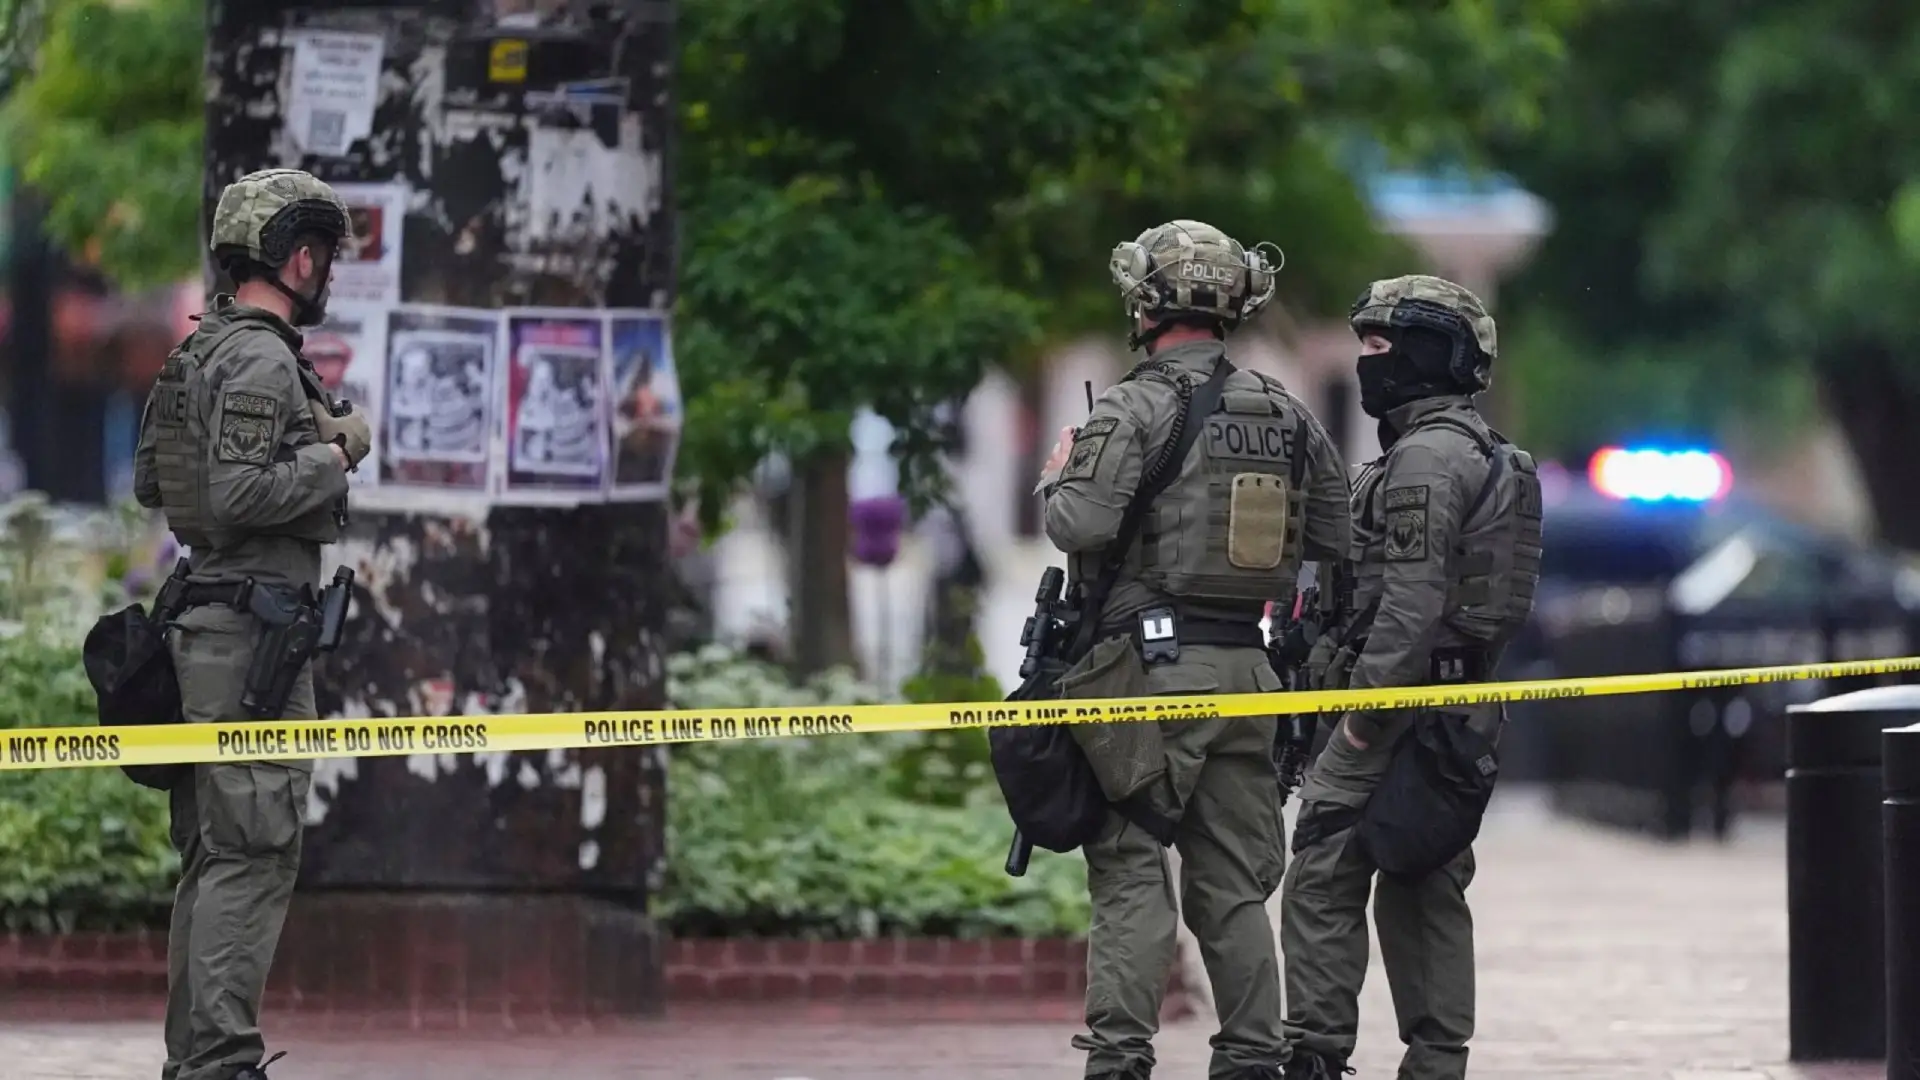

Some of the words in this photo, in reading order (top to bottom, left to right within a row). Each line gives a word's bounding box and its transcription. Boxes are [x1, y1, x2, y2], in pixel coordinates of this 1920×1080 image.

[1182, 261, 1233, 284] POLICE
[1209, 422, 1293, 459] POLICE
[217, 728, 288, 755] POLICE
[294, 727, 338, 753] LINE
[344, 726, 371, 751] DO
[378, 725, 415, 750] NOT
[422, 723, 488, 749] CROSS
[584, 719, 655, 743] POLICE
[661, 718, 704, 740] LINE
[711, 717, 737, 738] DO
[744, 716, 782, 736] NOT
[789, 714, 853, 736] CROSS
[9, 736, 48, 763] NOT
[54, 734, 120, 762] CROSS
